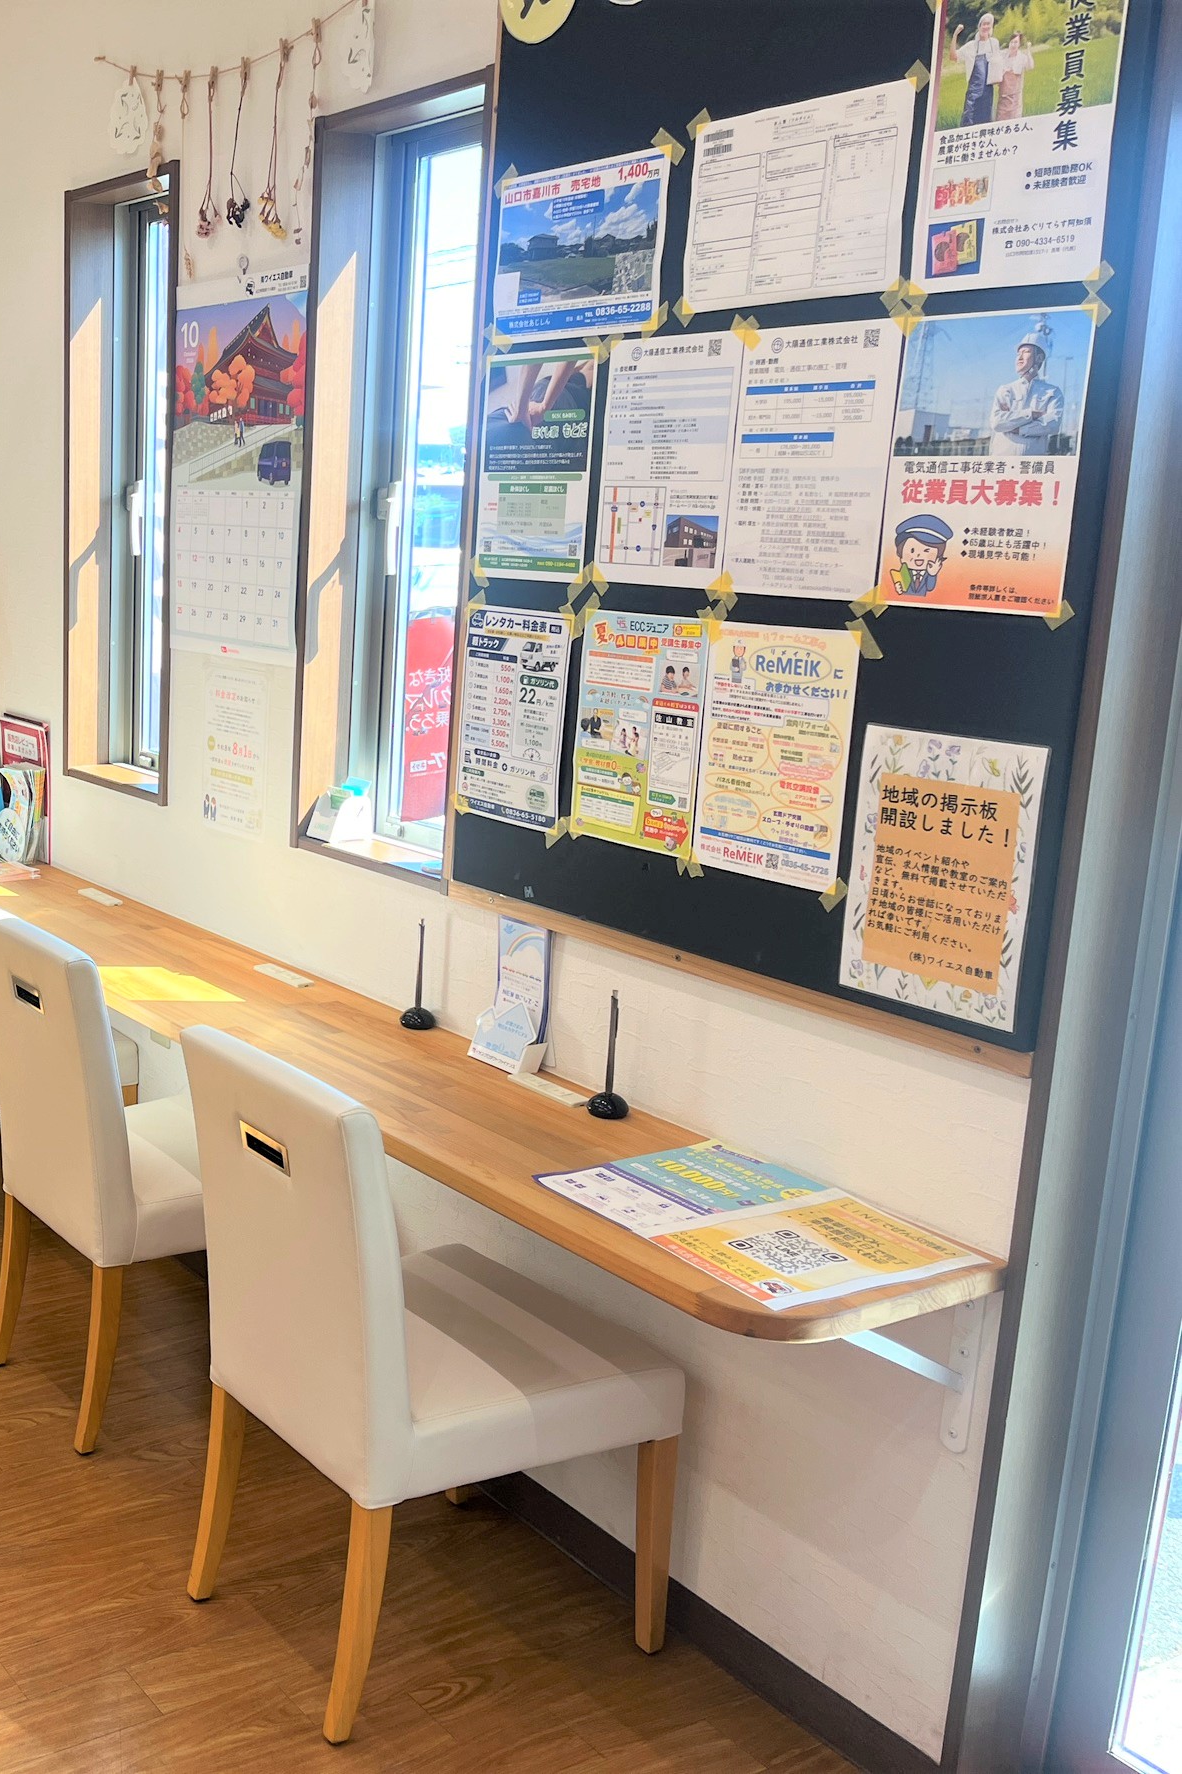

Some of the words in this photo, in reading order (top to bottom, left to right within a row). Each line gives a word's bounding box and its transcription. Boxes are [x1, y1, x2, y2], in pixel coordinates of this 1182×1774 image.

[939, 125, 1034, 145] 食品加工に興味がある人、
[937, 138, 998, 156] 農業が好きな人、
[1033, 161, 1093, 179] 短時間勤務OK
[570, 174, 602, 191] 売宅地
[1032, 174, 1087, 191] 未経験者歓迎
[992, 217, 1092, 235] 株式会社あぐりてらす阿知須
[1015, 235, 1076, 248] 090-4334-6519
[595, 302, 652, 317] 0836-65-2288
[181, 320, 200, 349] 10
[562, 421, 588, 438] もとだ
[904, 460, 1056, 475] 電気通信工事従業者・警備員
[901, 479, 1061, 507] 従業員大募集！
[970, 527, 1031, 537] 未経験者歓迎！
[969, 538, 1047, 550] 65歳以上も活躍中！
[967, 550, 1036, 562] 現場見学も可能！
[485, 615, 547, 633] レンタカー料金表
[630, 620, 670, 634] ECCジュニア
[471, 636, 500, 649] 軽トラック
[771, 648, 811, 658] リメイク
[755, 654, 822, 678] ReMEIK
[833, 668, 844, 680] に
[530, 678, 555, 689] ガソリン代
[765, 681, 848, 700] おまかせください！
[779, 780, 820, 795] 電気空調設備
[881, 783, 998, 822] 地域の掲示板
[880, 807, 1010, 848] 開設しました！
[700, 843, 722, 855] 株式会社
[723, 846, 764, 866] ReMEIK
[876, 844, 970, 868] 地域のイベント紹介や
[875, 854, 1008, 891] 宣伝、求人情報や教室のご案内
[873, 876, 904, 891] きます。
[874, 865, 1007, 902] など、無料で掲載させていただ
[871, 888, 1002, 924] 日頃からお世話になっておりま
[867, 909, 928, 931] れば幸いです。
[870, 898, 1001, 936] す地域の皆様にご活用いただけ
[867, 919, 972, 953] お気軽にご利用ください。
[908, 951, 994, 980] (株)ワイエス自動車
